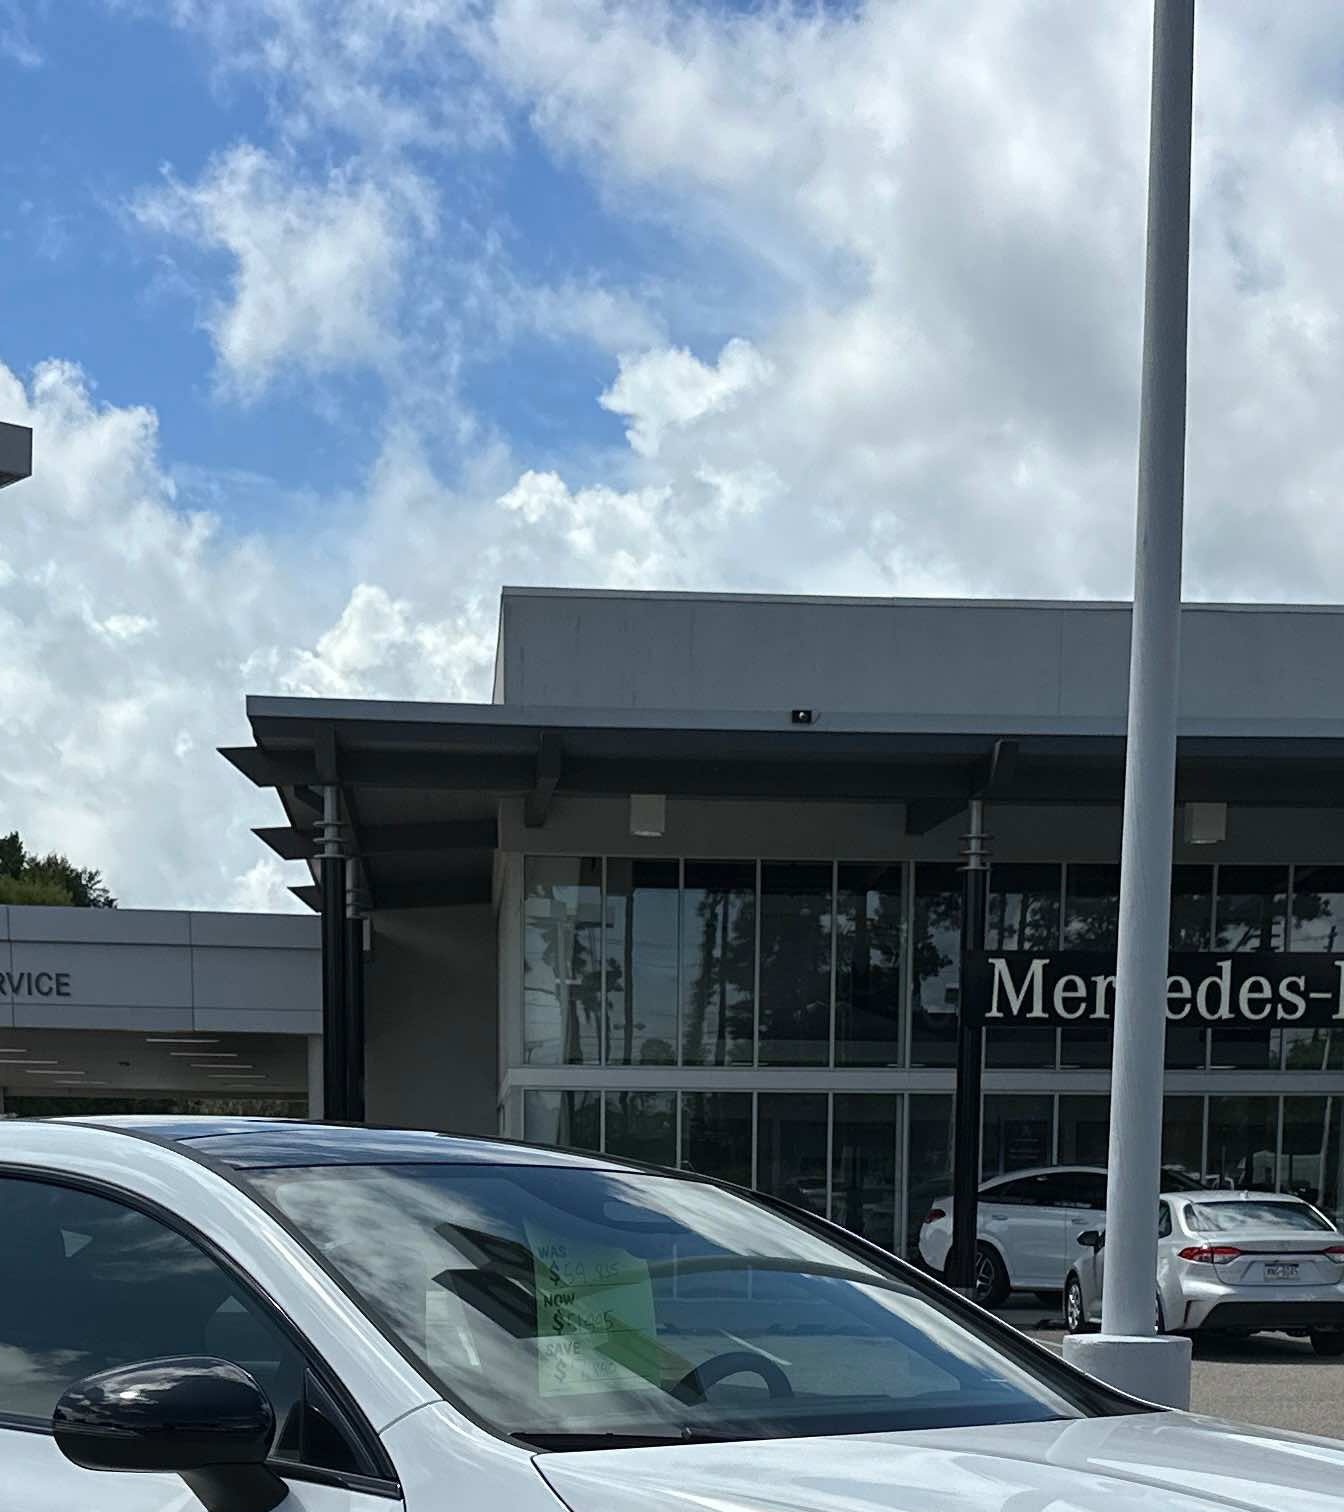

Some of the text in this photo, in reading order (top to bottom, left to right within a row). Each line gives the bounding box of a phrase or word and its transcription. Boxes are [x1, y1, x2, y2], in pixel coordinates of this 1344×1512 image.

[538, 1245, 568, 1258] WAS
[543, 1293, 576, 1308] NOW
[545, 1342, 582, 1357] SAVE
